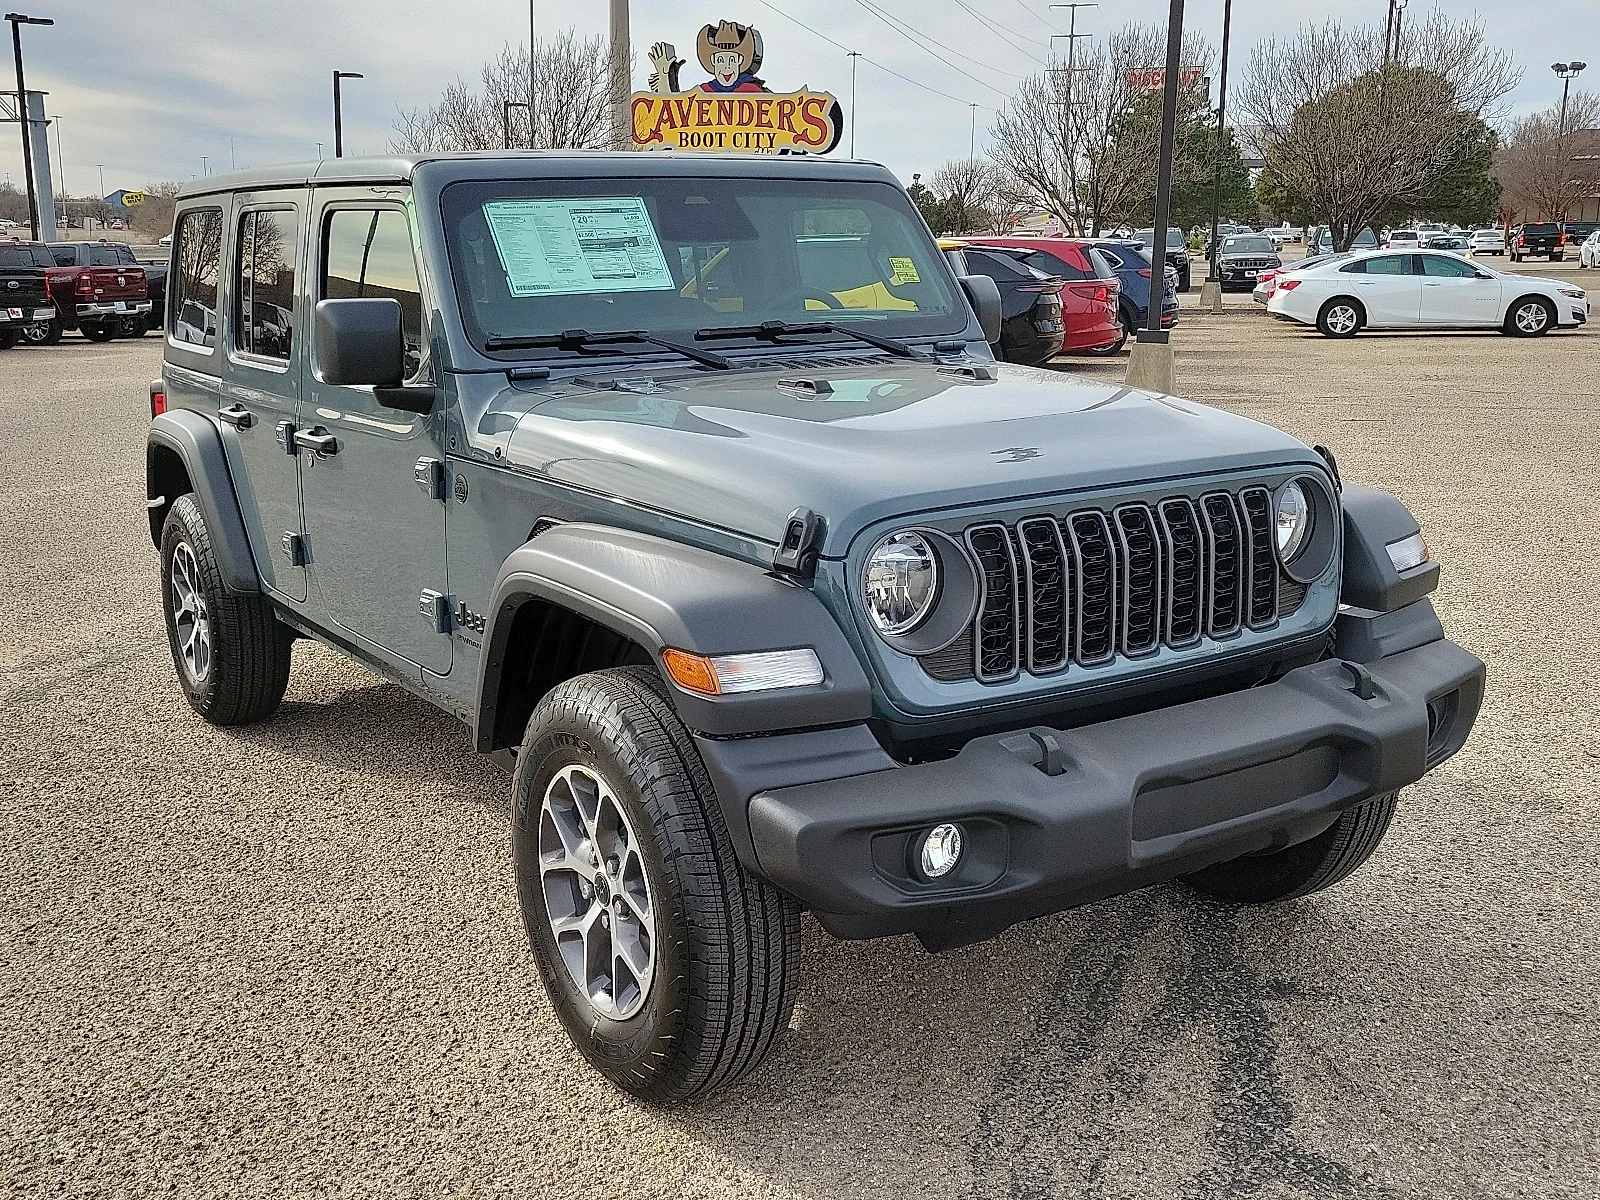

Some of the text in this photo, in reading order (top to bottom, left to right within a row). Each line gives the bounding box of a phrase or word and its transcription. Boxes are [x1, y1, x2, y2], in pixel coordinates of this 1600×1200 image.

[1128, 68, 1201, 89] DISCNT
[631, 94, 828, 145] CAVENDER'S
[678, 131, 778, 149] BOOT CITY
